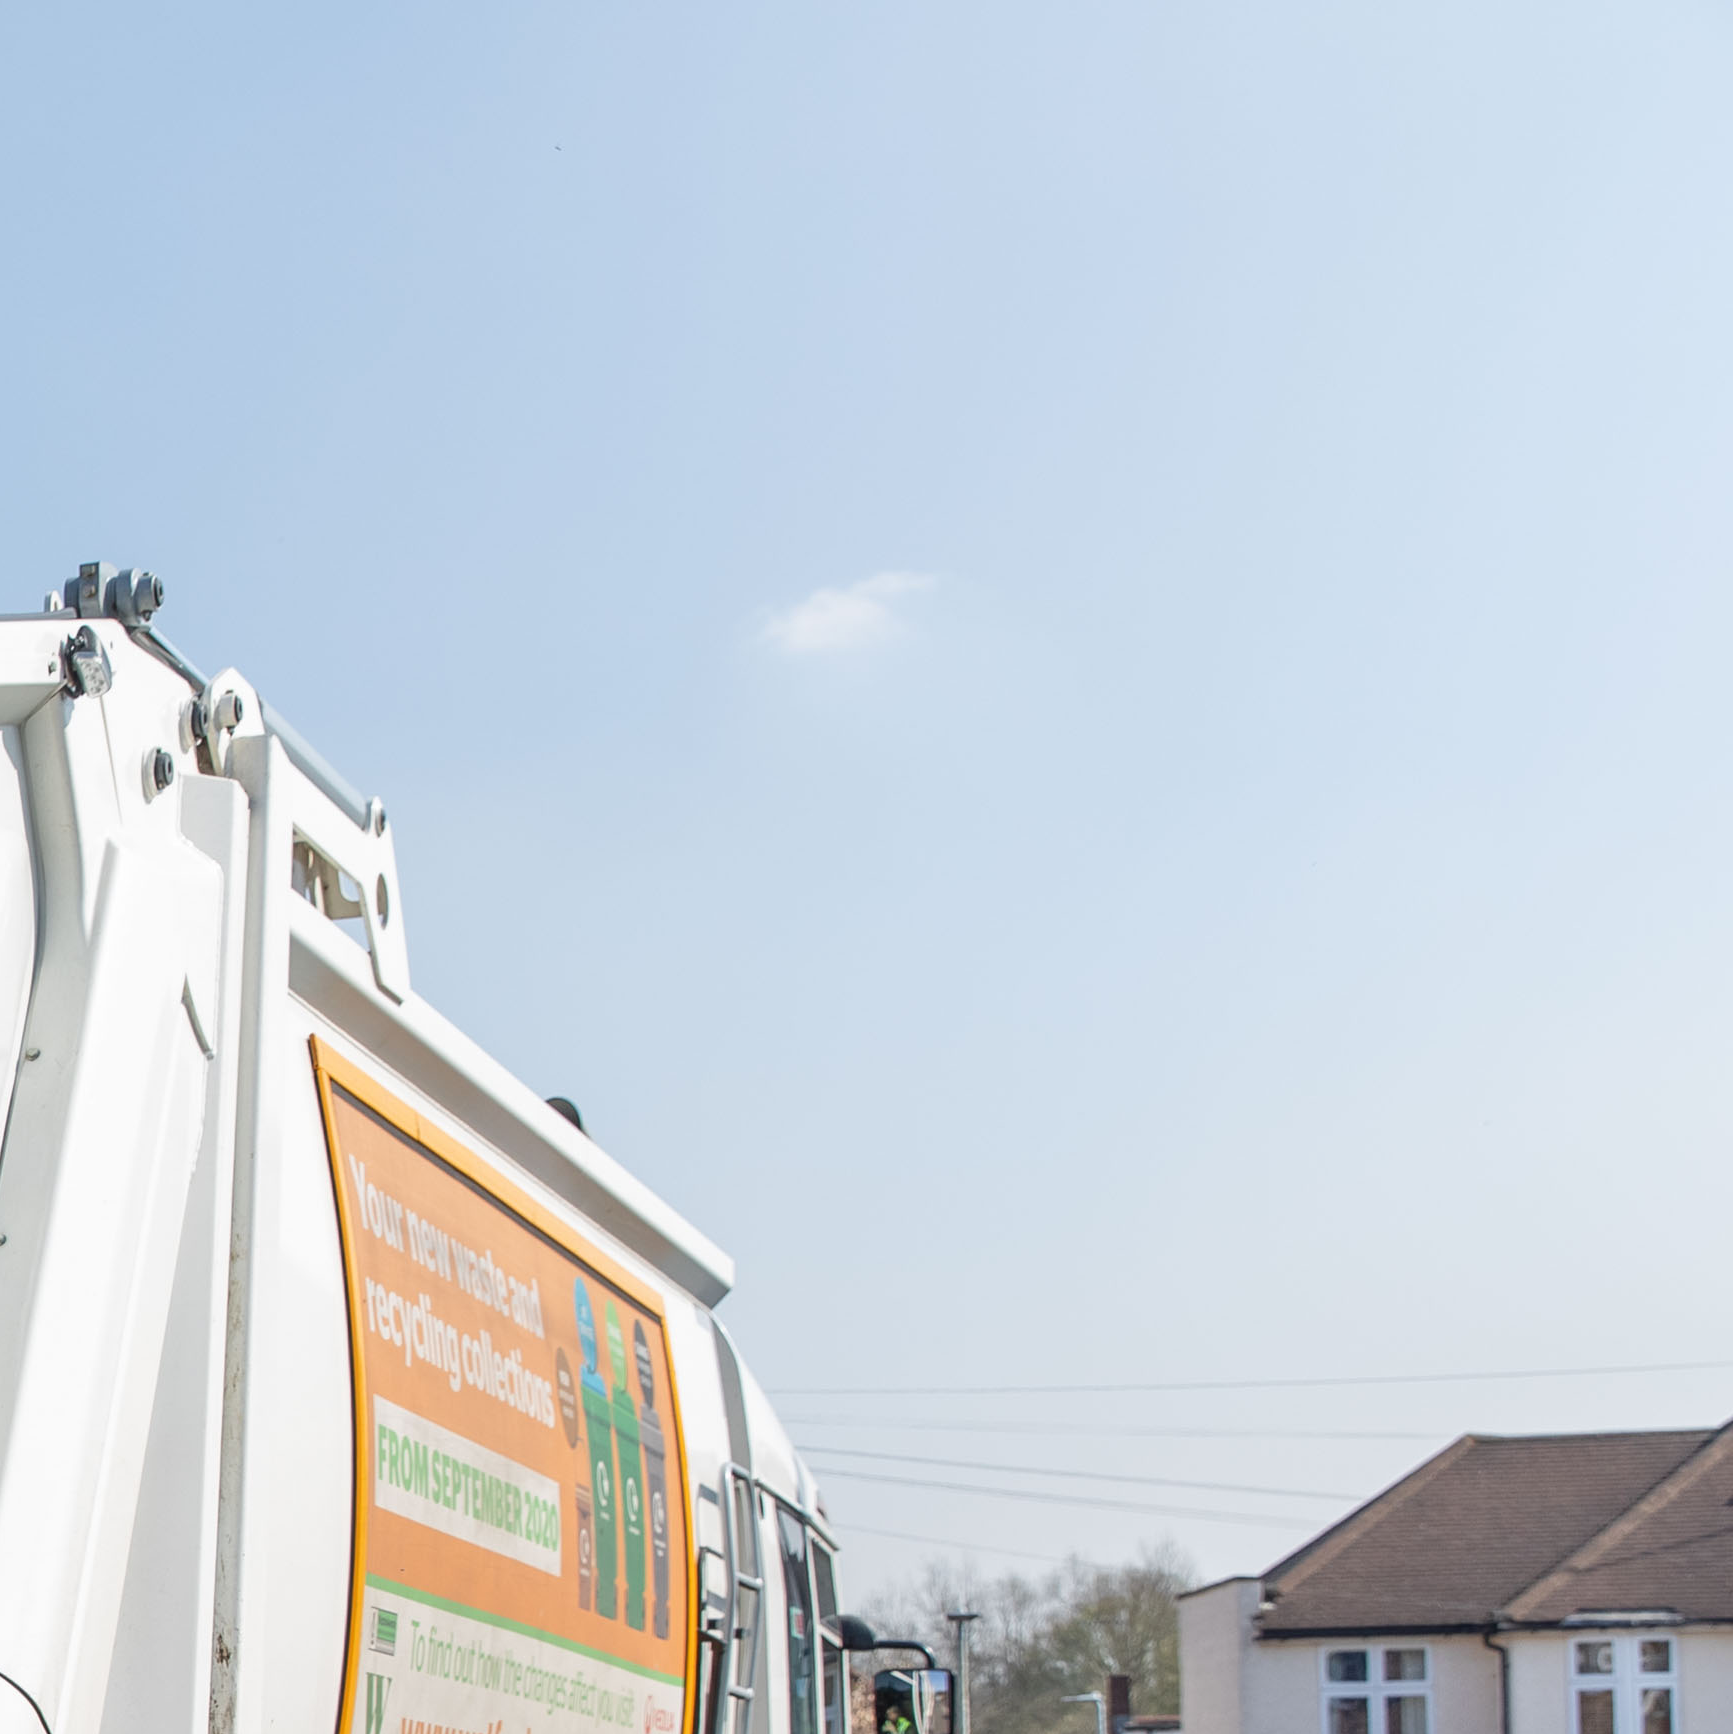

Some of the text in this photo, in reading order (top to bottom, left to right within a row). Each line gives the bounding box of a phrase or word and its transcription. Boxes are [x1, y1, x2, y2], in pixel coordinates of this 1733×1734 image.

[349, 1153, 404, 1253] Your
[406, 1209, 451, 1282] new
[451, 1237, 509, 1317] waste
[508, 1278, 545, 1340] and
[365, 1276, 462, 1392] recycling
[461, 1329, 555, 1429] collections
[378, 1424, 559, 1552] FROM SEPTEMBER 2020
[410, 1620, 426, 1672] To
[426, 1625, 453, 1679] find
[454, 1640, 476, 1686] out
[476, 1639, 502, 1691] how
[503, 1650, 523, 1697] the
[523, 1655, 568, 1716] changes
